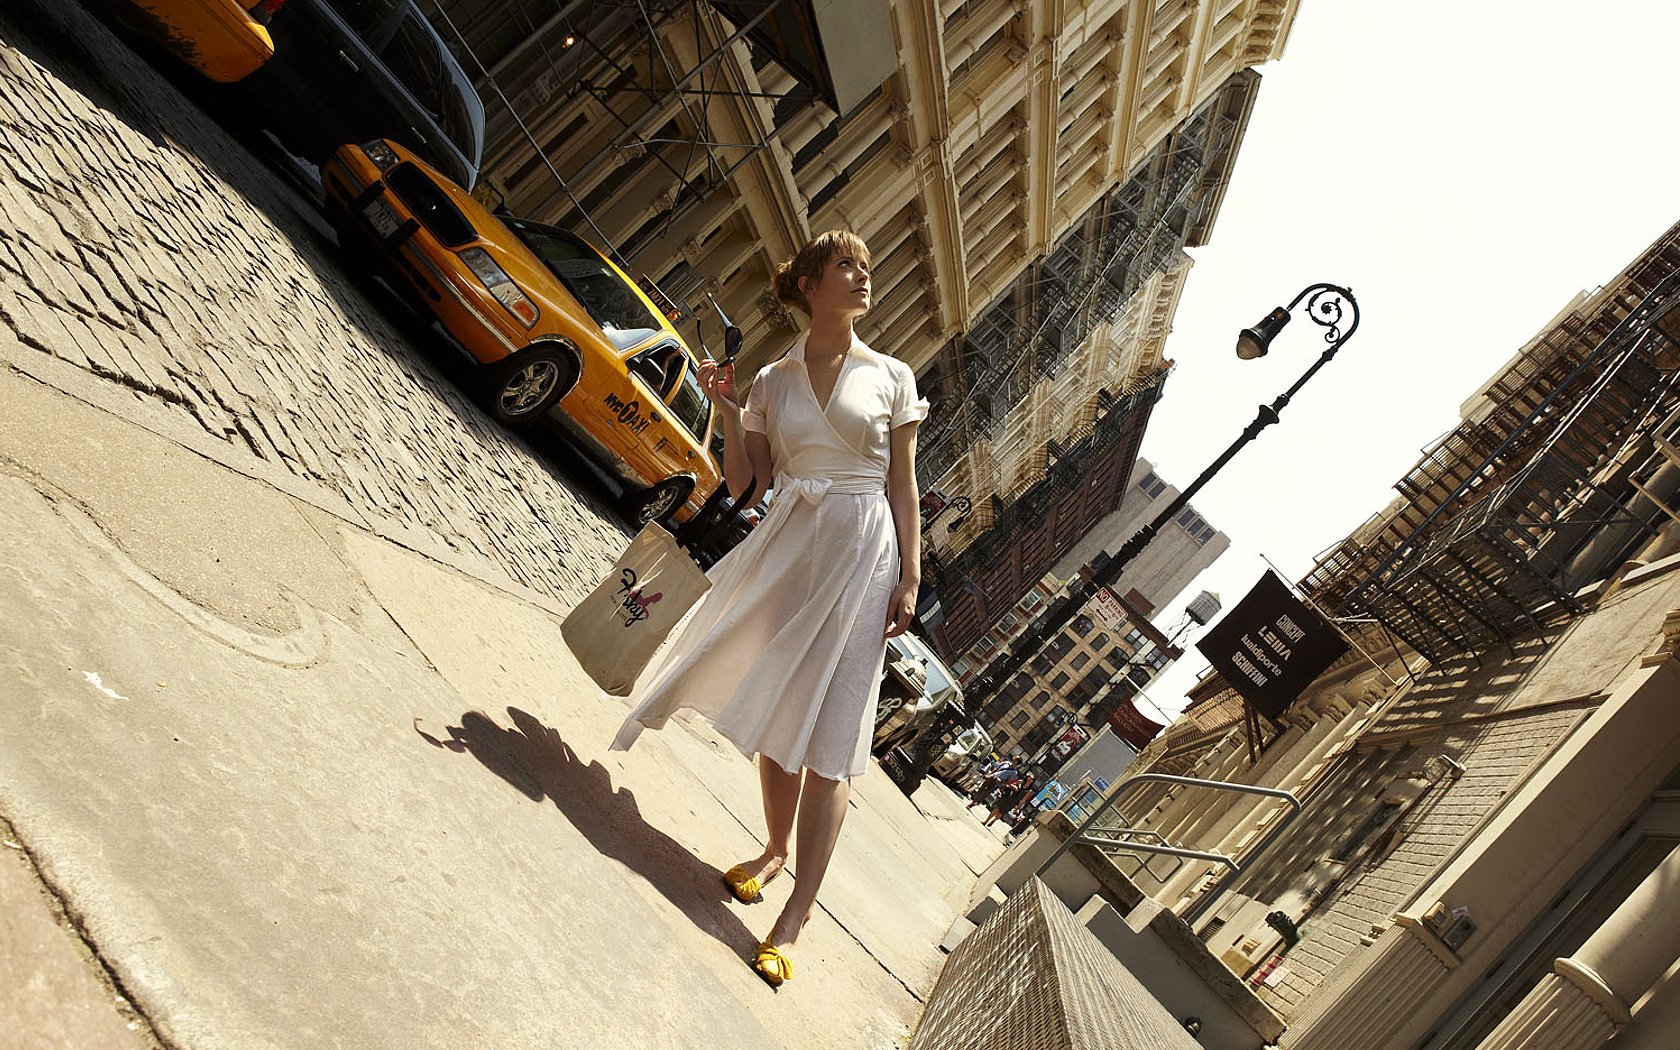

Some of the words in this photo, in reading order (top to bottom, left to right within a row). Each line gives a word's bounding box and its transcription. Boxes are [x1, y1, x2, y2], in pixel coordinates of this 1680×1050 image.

[603, 392, 625, 413] NYC
[1096, 589, 1110, 603] NO
[1275, 614, 1306, 643] CONCEPT
[1231, 651, 1268, 687] SCHIFFINI
